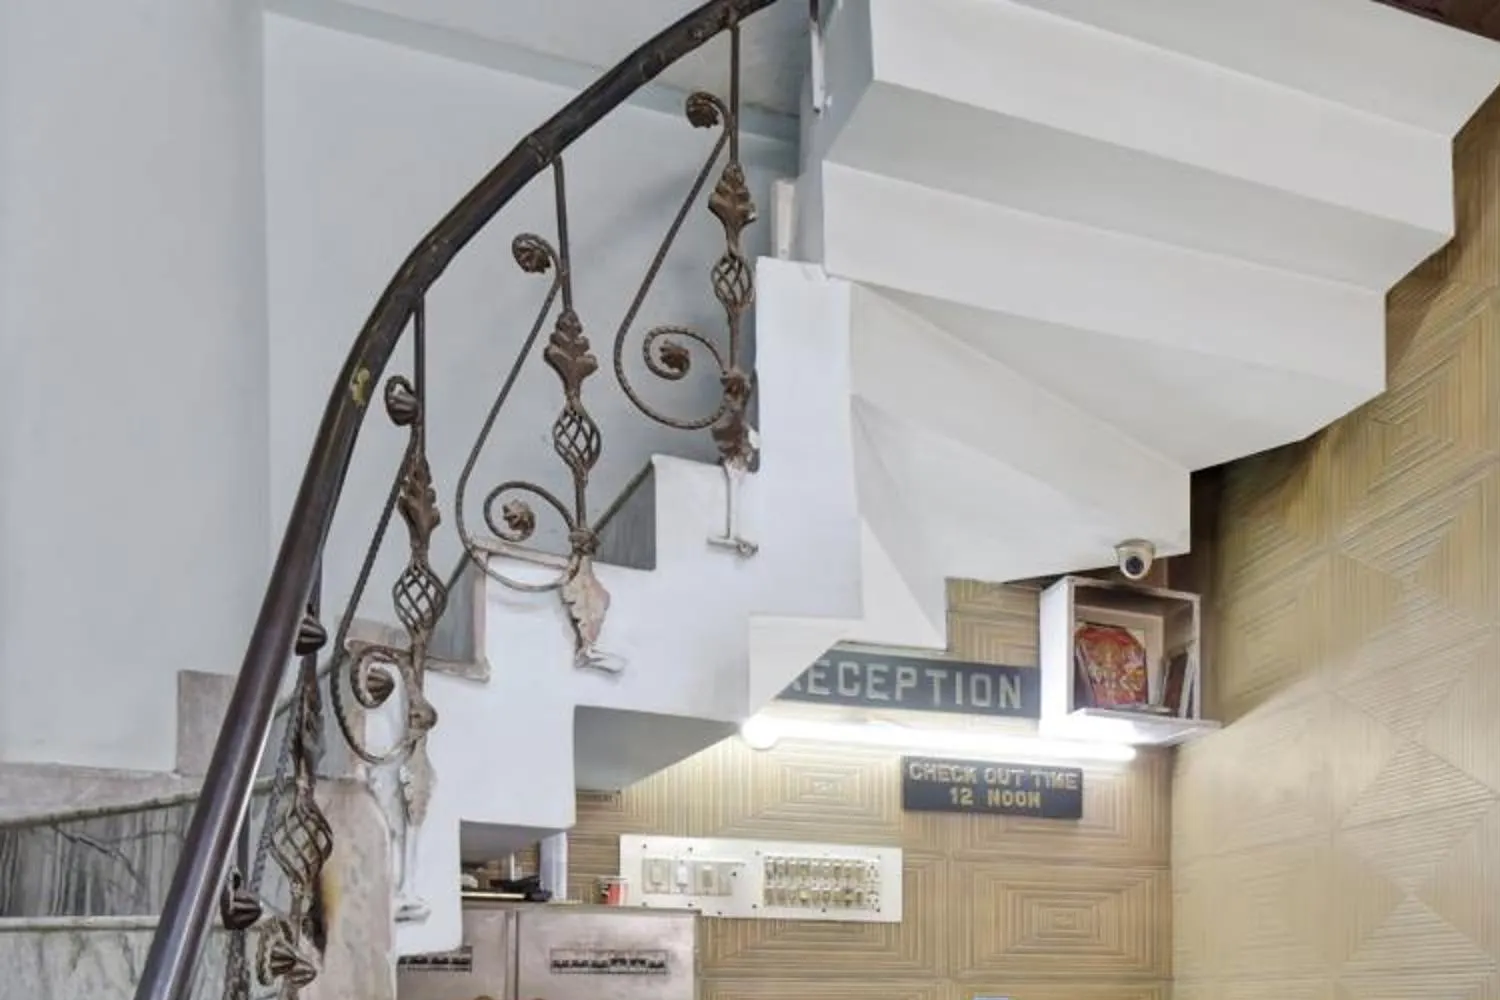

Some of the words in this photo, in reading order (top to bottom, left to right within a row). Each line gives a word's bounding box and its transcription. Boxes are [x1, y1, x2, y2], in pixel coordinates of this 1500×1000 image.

[792, 660, 1022, 709] ECEPTION
[909, 762, 977, 785] CHECK
[984, 769, 1025, 787] OUT
[1030, 770, 1078, 790] TIME
[949, 787, 974, 807] 12
[987, 789, 1042, 809] NOON
